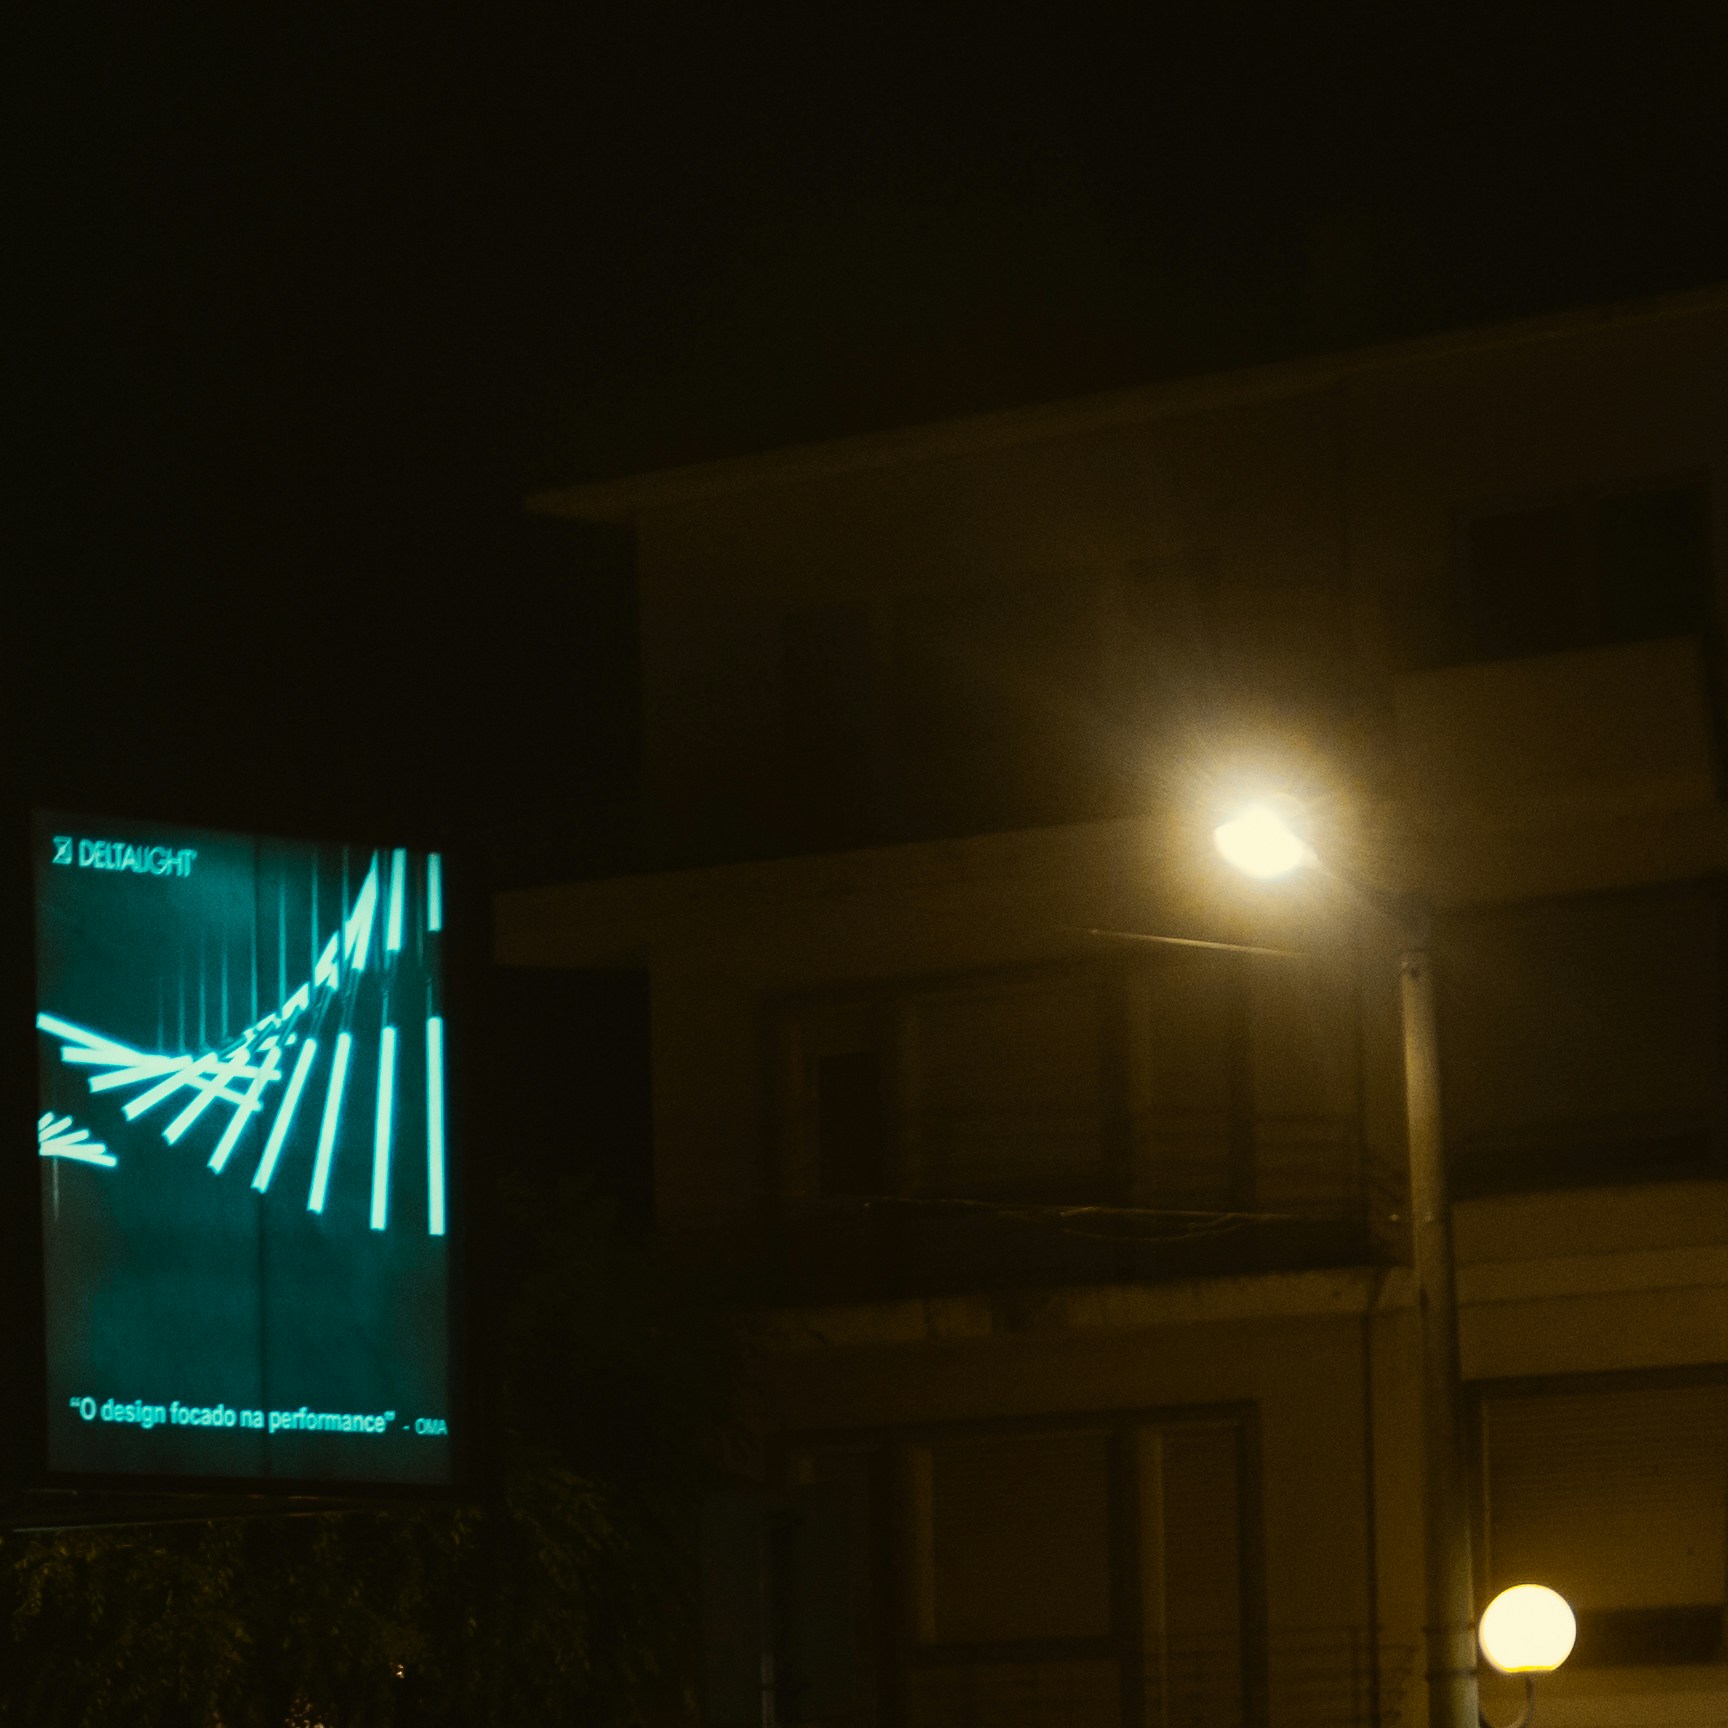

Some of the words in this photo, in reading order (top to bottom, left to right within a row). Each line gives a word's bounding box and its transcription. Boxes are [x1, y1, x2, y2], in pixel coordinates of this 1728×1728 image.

[100, 1399, 166, 1429] design
[169, 1401, 236, 1428] focado
[240, 1409, 265, 1429] na
